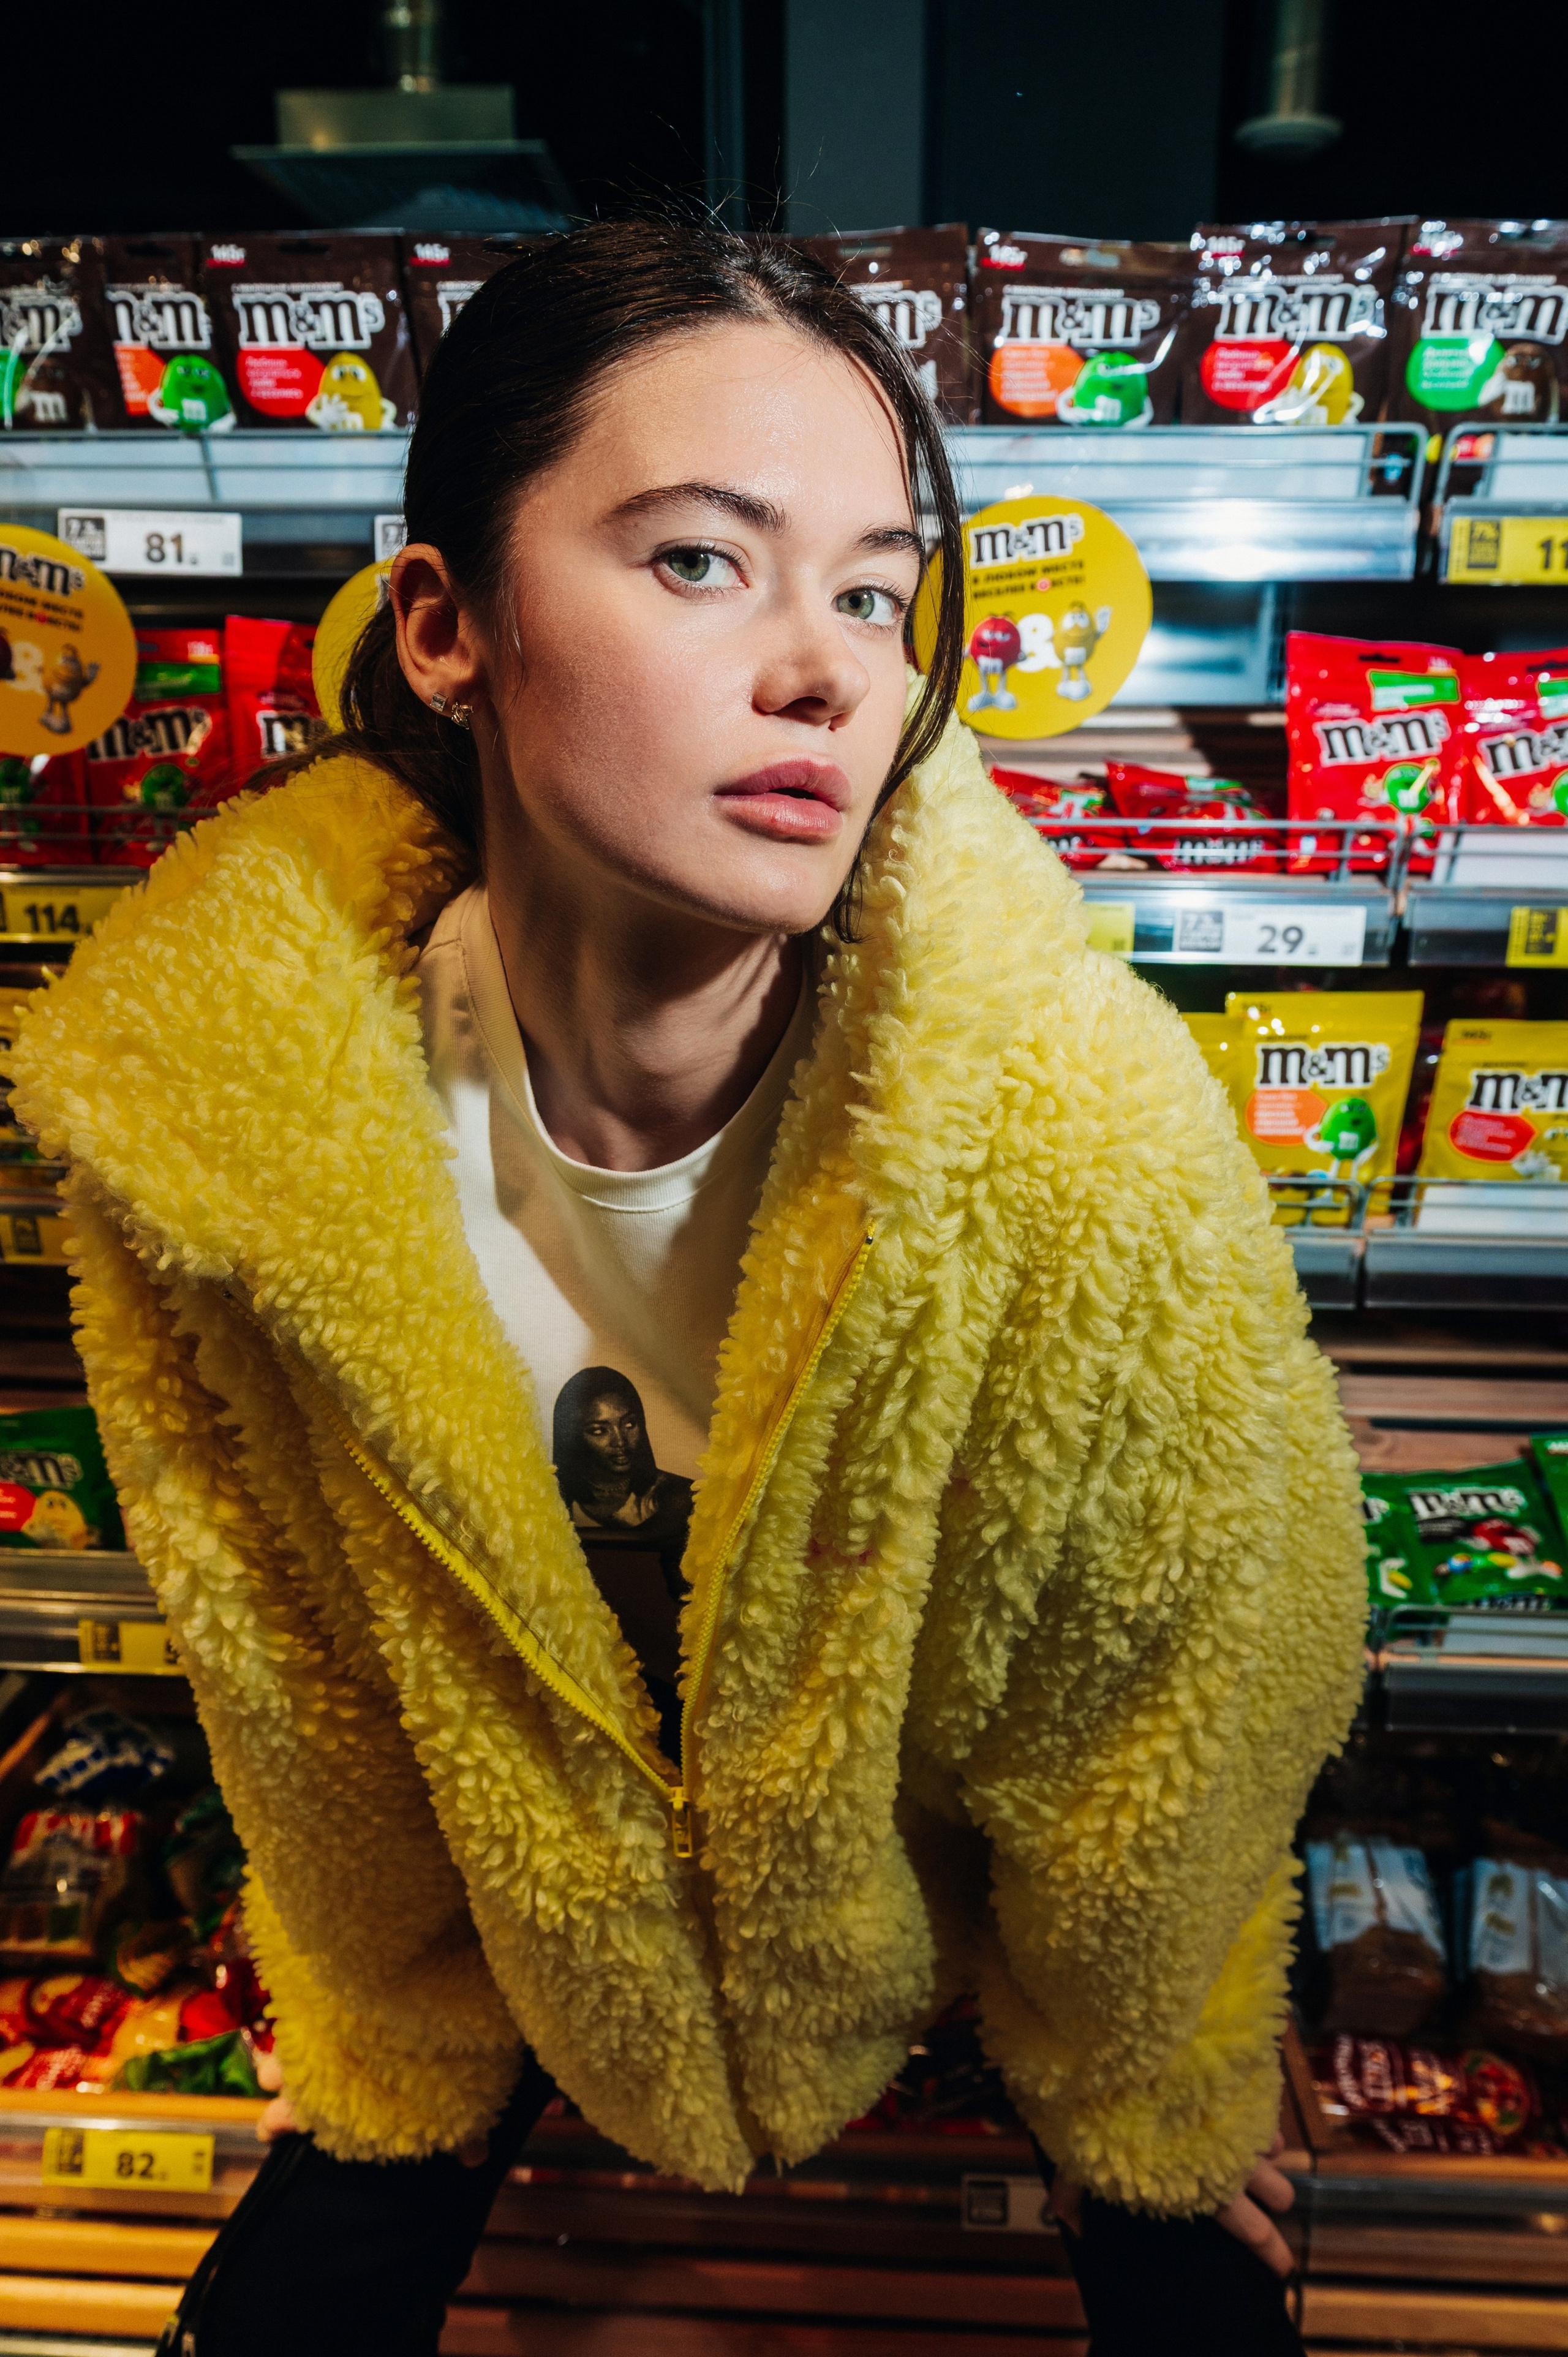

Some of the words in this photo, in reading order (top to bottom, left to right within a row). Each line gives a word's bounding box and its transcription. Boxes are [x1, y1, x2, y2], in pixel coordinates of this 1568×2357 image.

[24, 903, 80, 933] 114
[1257, 925, 1303, 953] 29
[116, 2151, 154, 2179] 82
